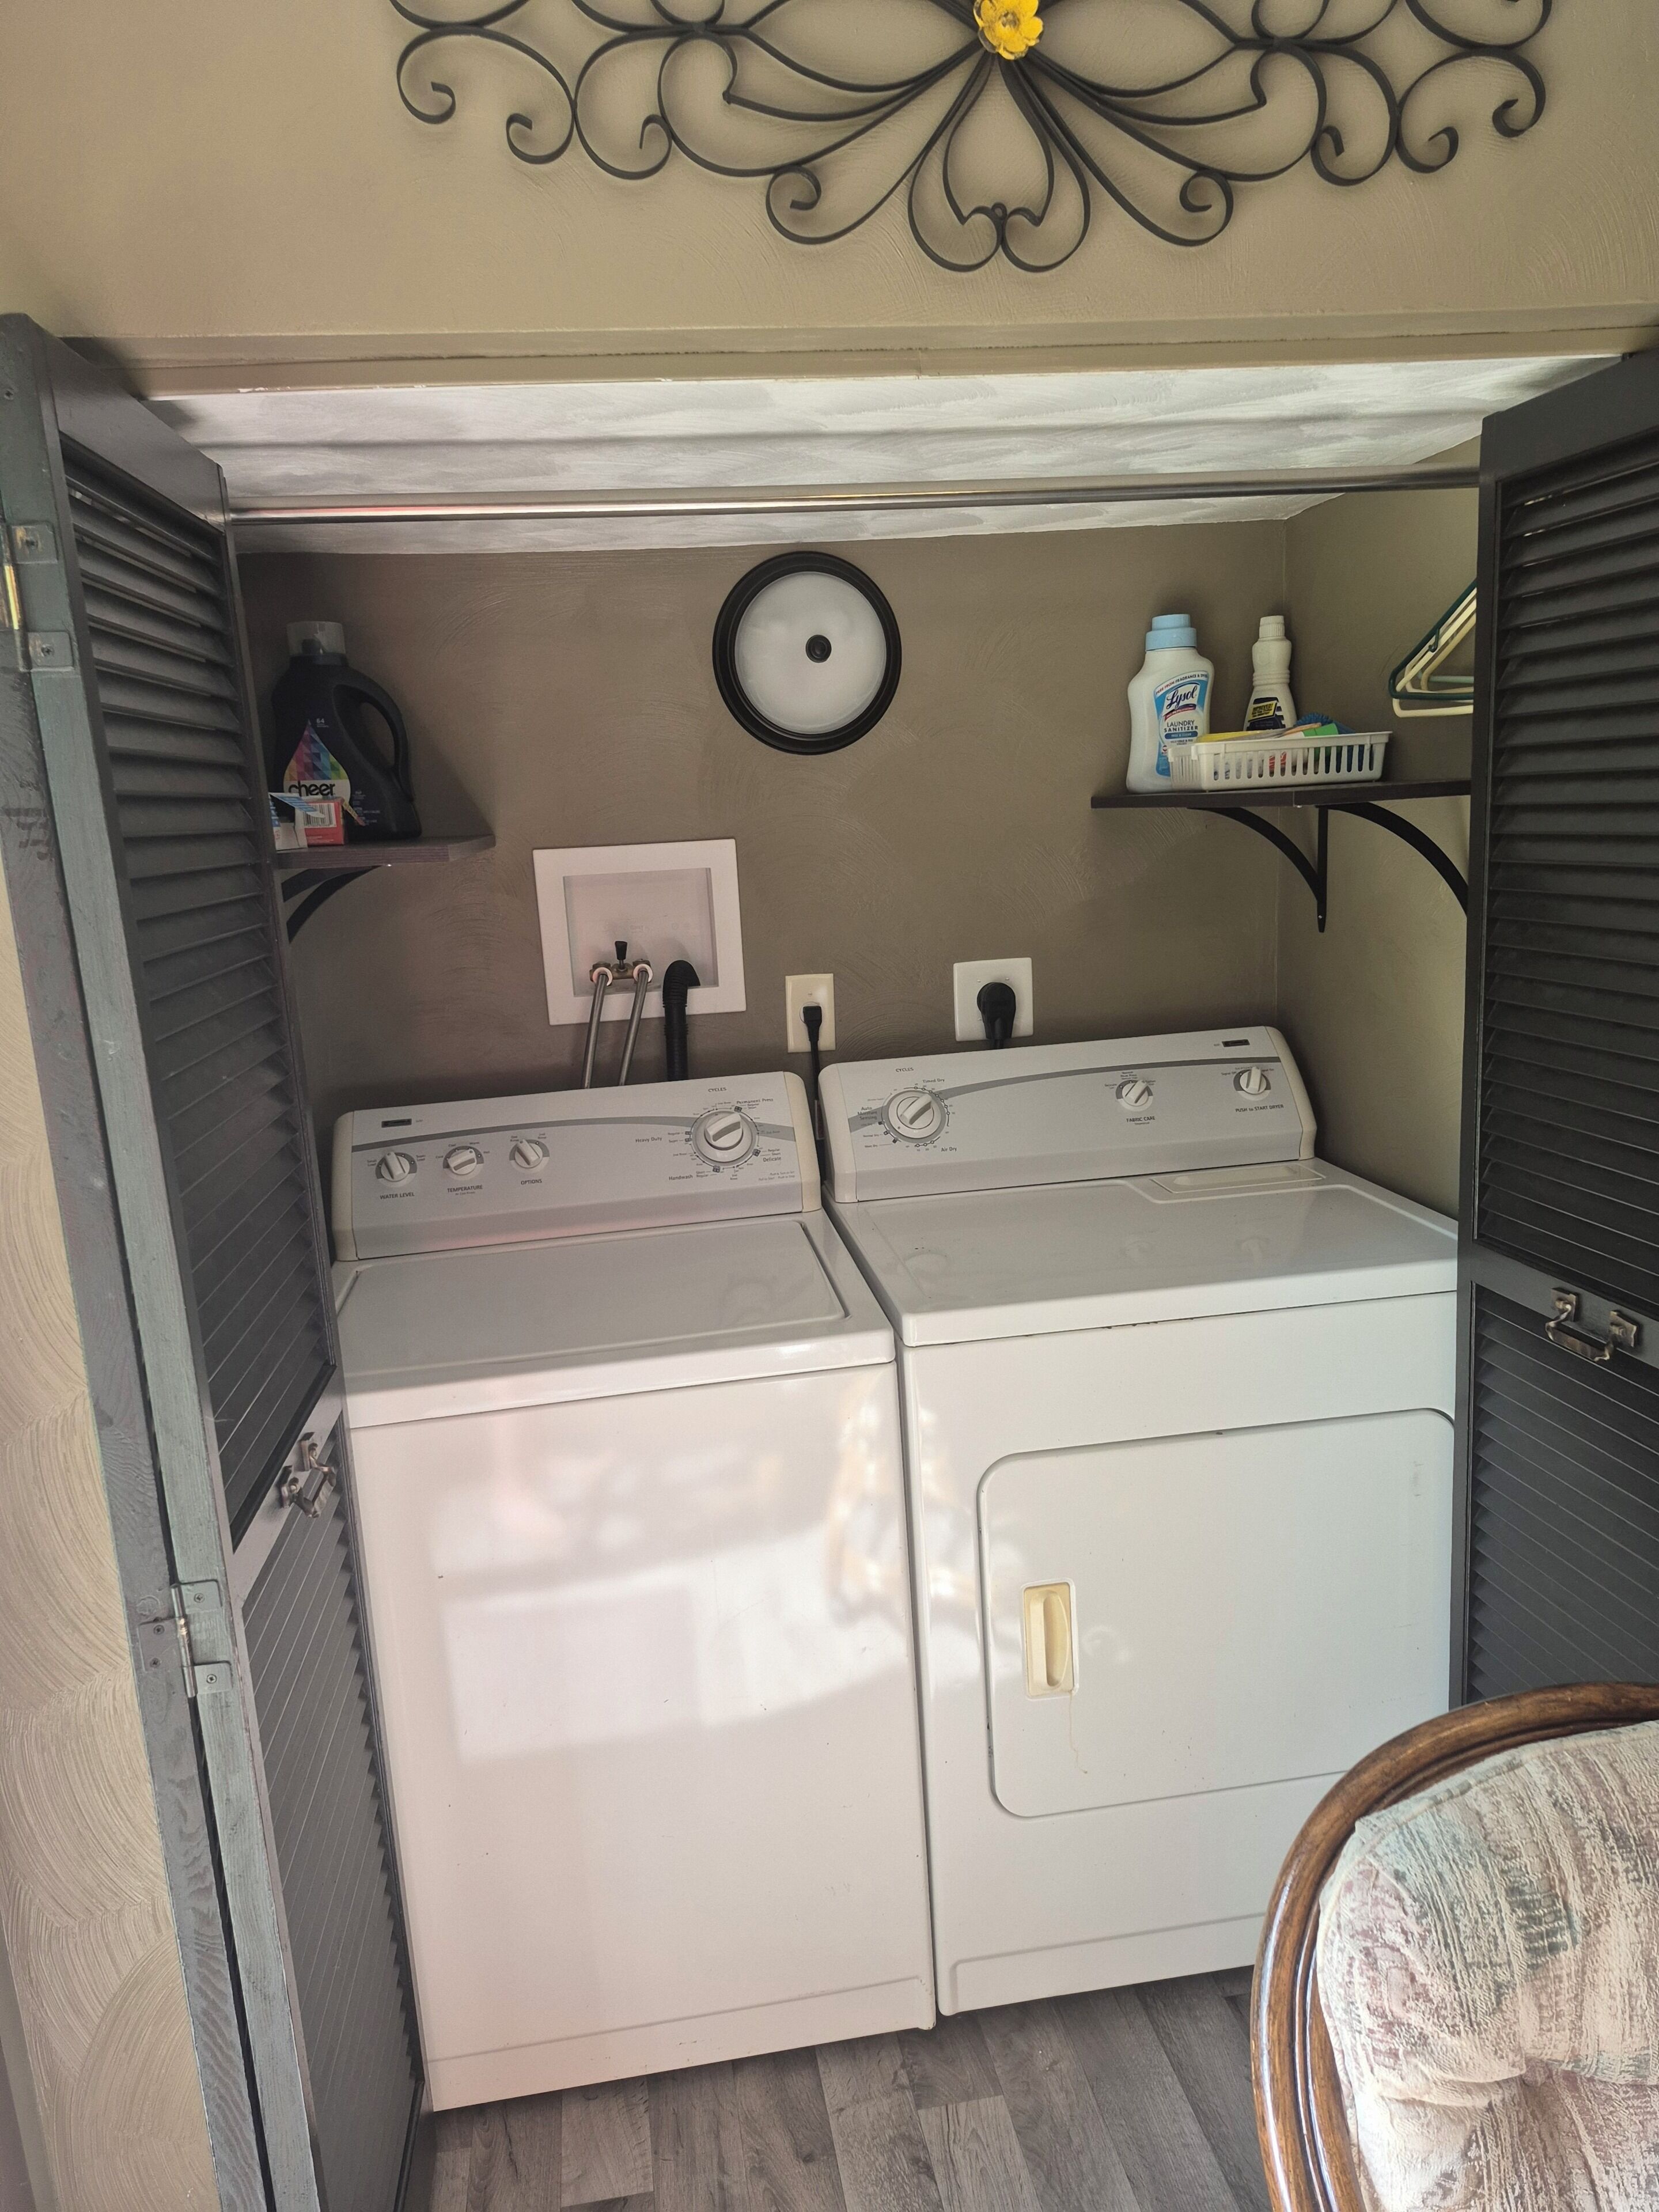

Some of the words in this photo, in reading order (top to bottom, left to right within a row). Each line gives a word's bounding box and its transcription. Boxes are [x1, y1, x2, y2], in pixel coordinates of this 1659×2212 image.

[1164, 680, 1175, 688] FROM
[1175, 674, 1196, 683] FRAGRANCE
[1166, 684, 1198, 710] Lysol
[1167, 719, 1195, 728] LAUNDRY
[288, 780, 336, 797] cheer
[447, 1184, 483, 1193] TEMPERATURE
